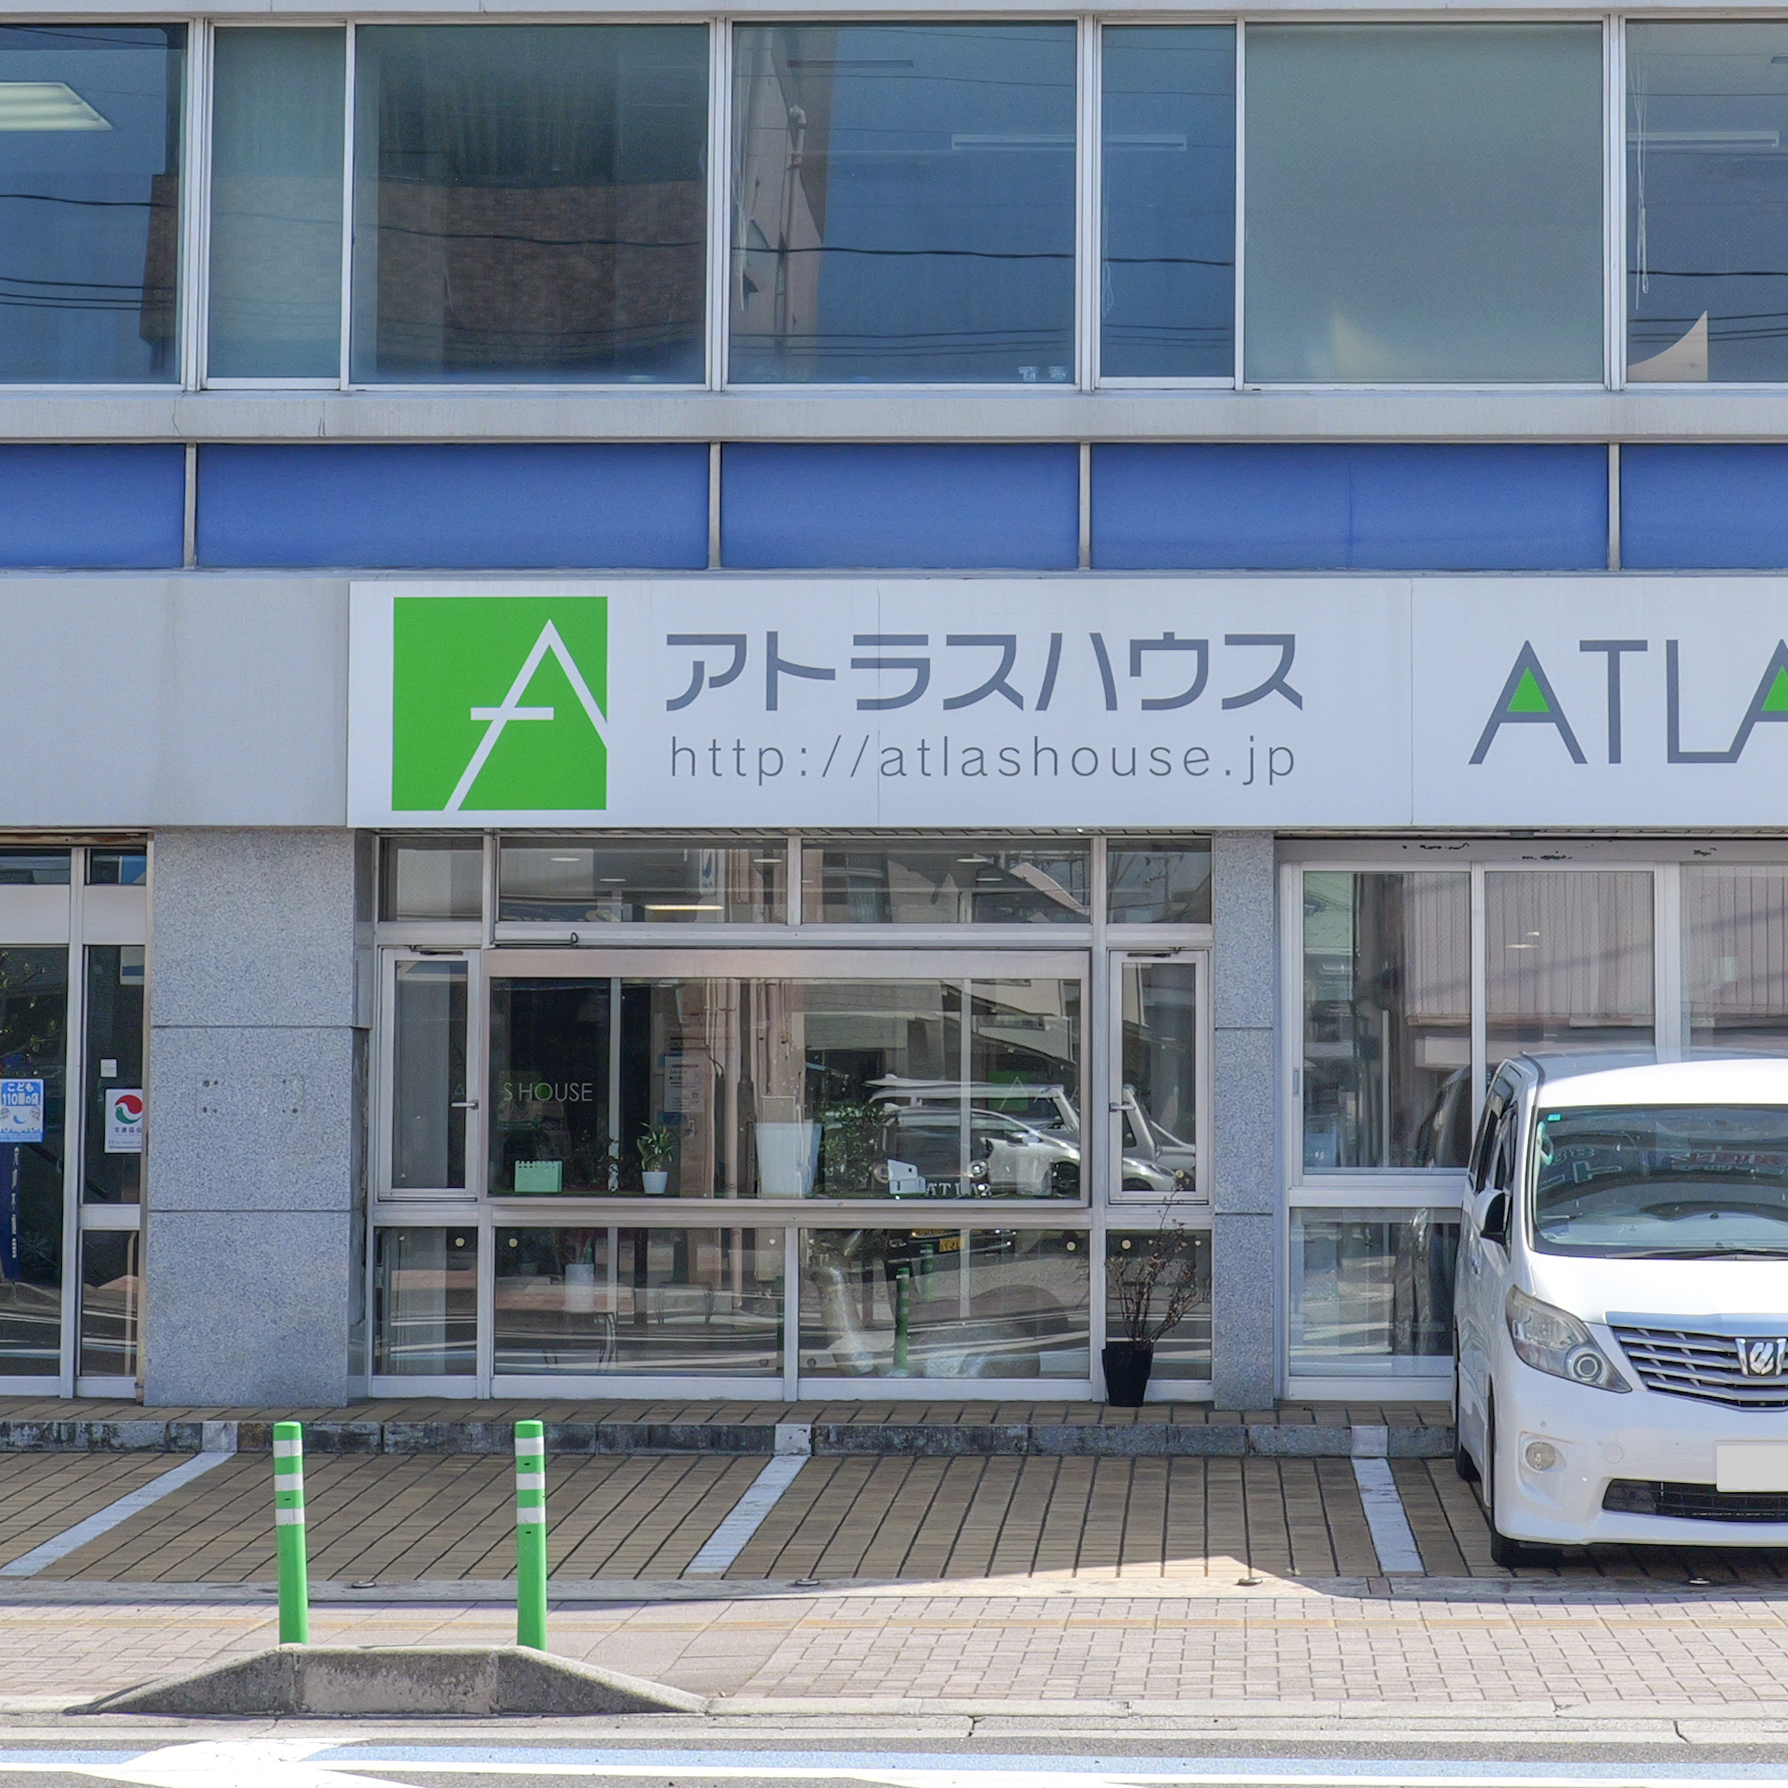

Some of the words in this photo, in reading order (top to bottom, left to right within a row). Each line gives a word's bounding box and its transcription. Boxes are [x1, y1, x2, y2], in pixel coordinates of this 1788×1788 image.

[666, 630, 1303, 712] アトラスハウス
[670, 735, 1295, 787] http://atlashouse.jp
[518, 1082, 592, 1101] HOUSE
